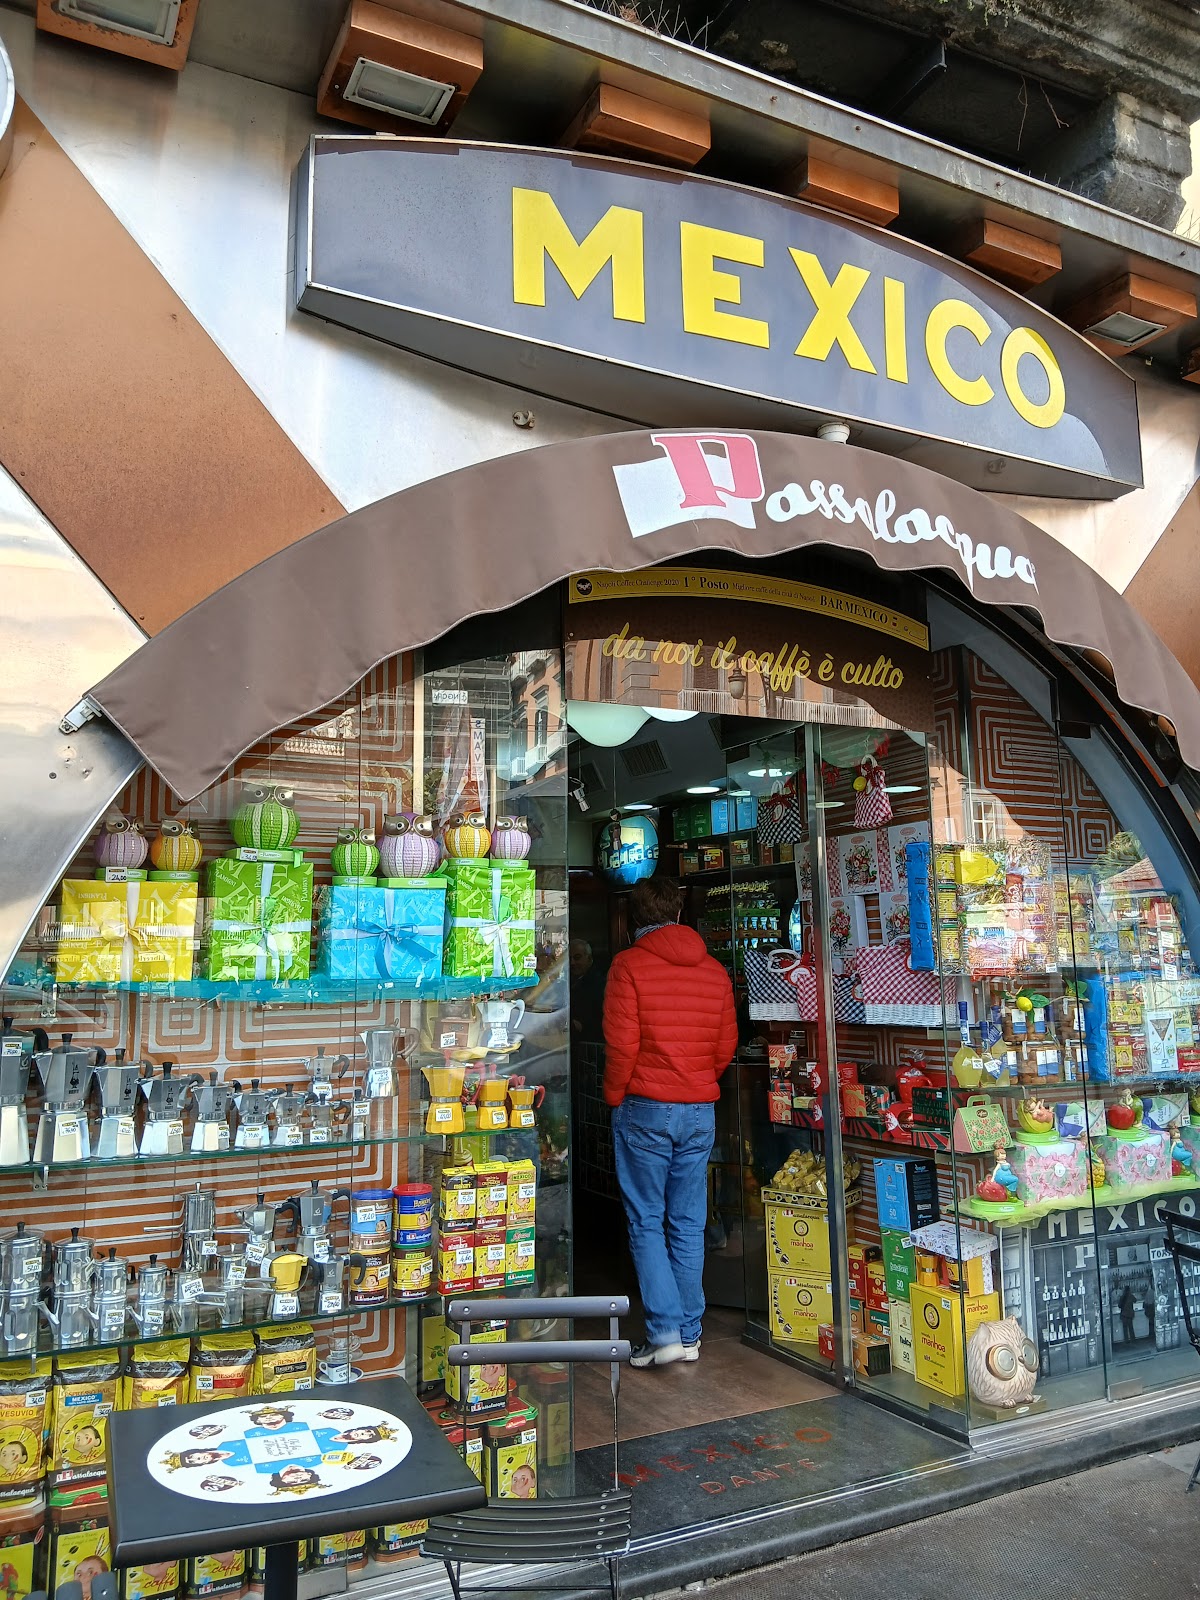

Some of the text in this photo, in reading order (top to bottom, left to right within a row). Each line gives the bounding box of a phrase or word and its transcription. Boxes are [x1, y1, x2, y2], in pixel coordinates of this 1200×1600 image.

[512, 186, 1066, 428] MEXICO
[650, 433, 1039, 595] Passalacqua
[616, 578, 635, 587] Coffee
[700, 576, 729, 590] Posto
[820, 595, 843, 611] BAR
[844, 601, 888, 625] MEXICO
[602, 622, 905, 693] da noi il caffè è culto
[889, 1208, 897, 1216] 50
[1048, 1195, 1196, 1240] MEXICO
[896, 1279, 904, 1288] 50
[966, 1300, 989, 1313] manhoa
[921, 1334, 946, 1352] manhoa
[0, 1409, 34, 1417] VESUVIO
[71, 1394, 96, 1402] MEXICO
[609, 1427, 832, 1487] MEXICO
[700, 1458, 822, 1495] DANTE
